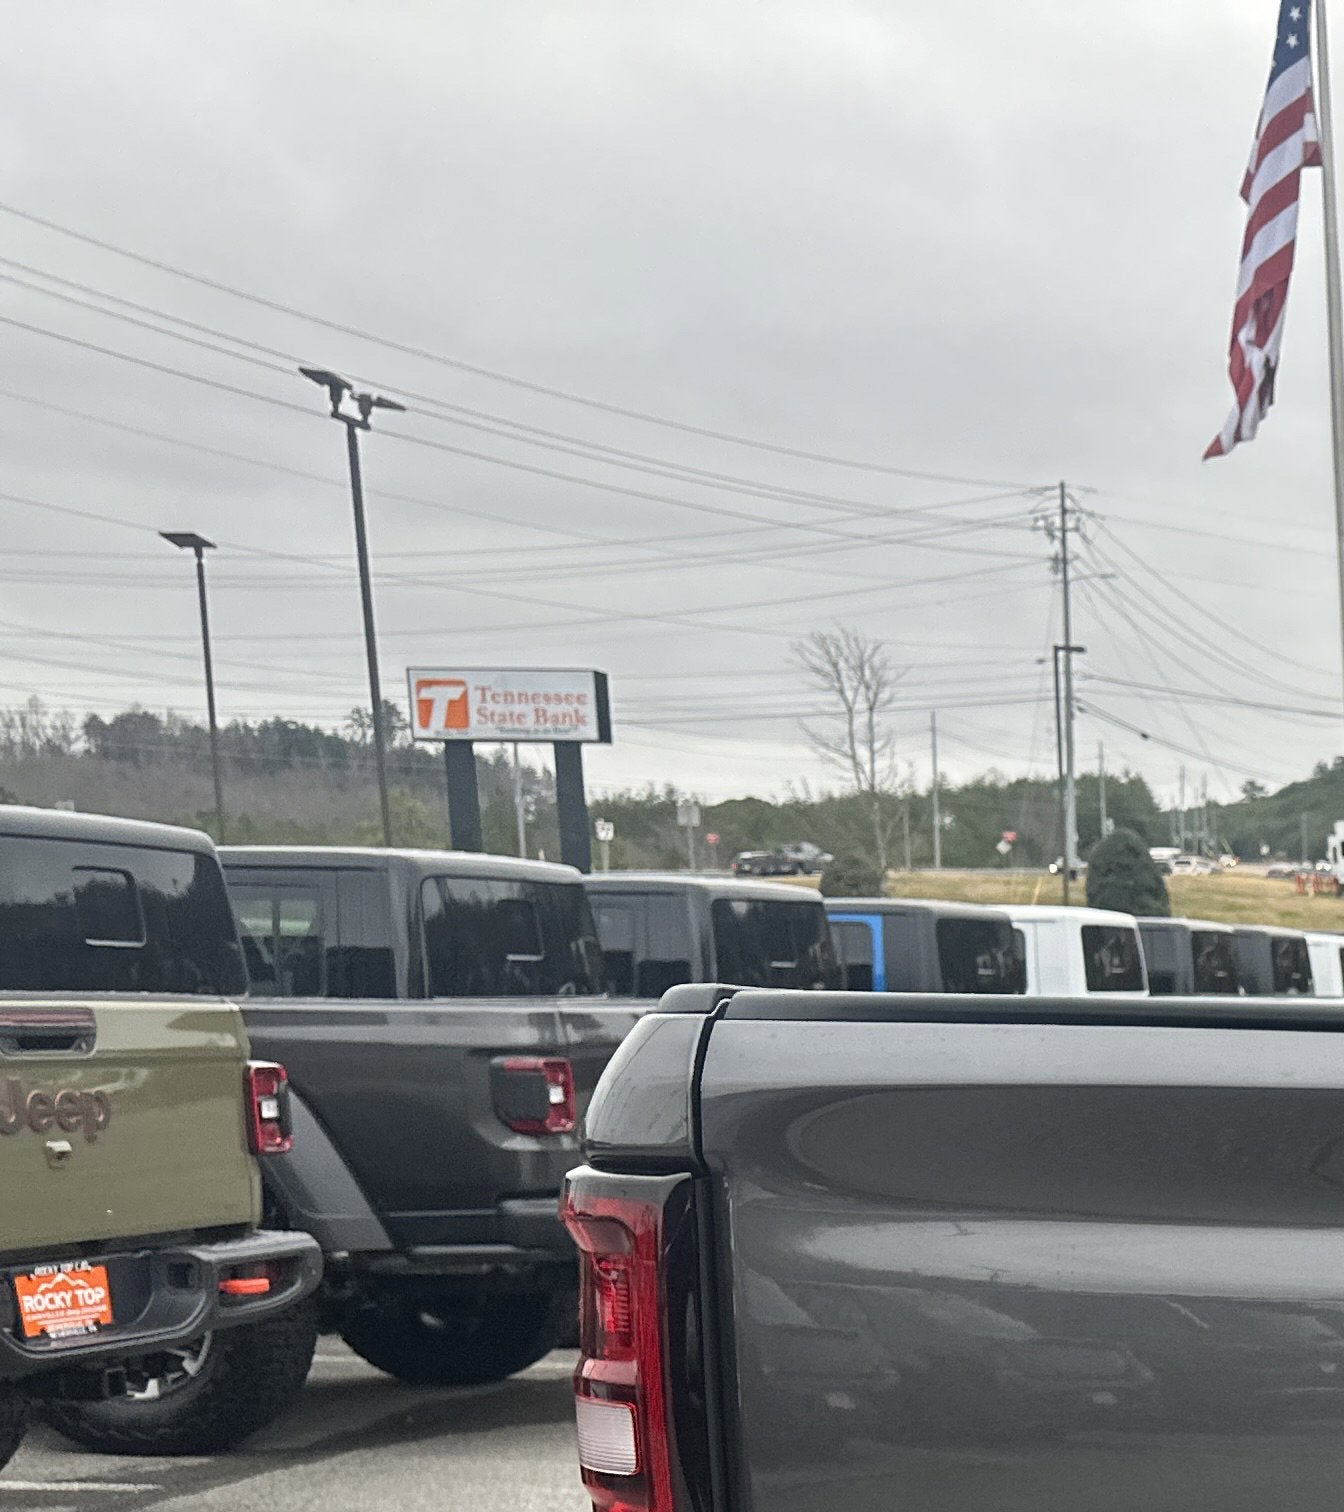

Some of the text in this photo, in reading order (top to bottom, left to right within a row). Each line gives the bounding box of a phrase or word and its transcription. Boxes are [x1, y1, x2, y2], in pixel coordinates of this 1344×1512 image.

[474, 684, 588, 706] Tennessee
[476, 706, 588, 727] State Bank
[0, 1077, 111, 1143] Jeep
[21, 1290, 73, 1313] ROCKY
[74, 1286, 105, 1306] TOP
